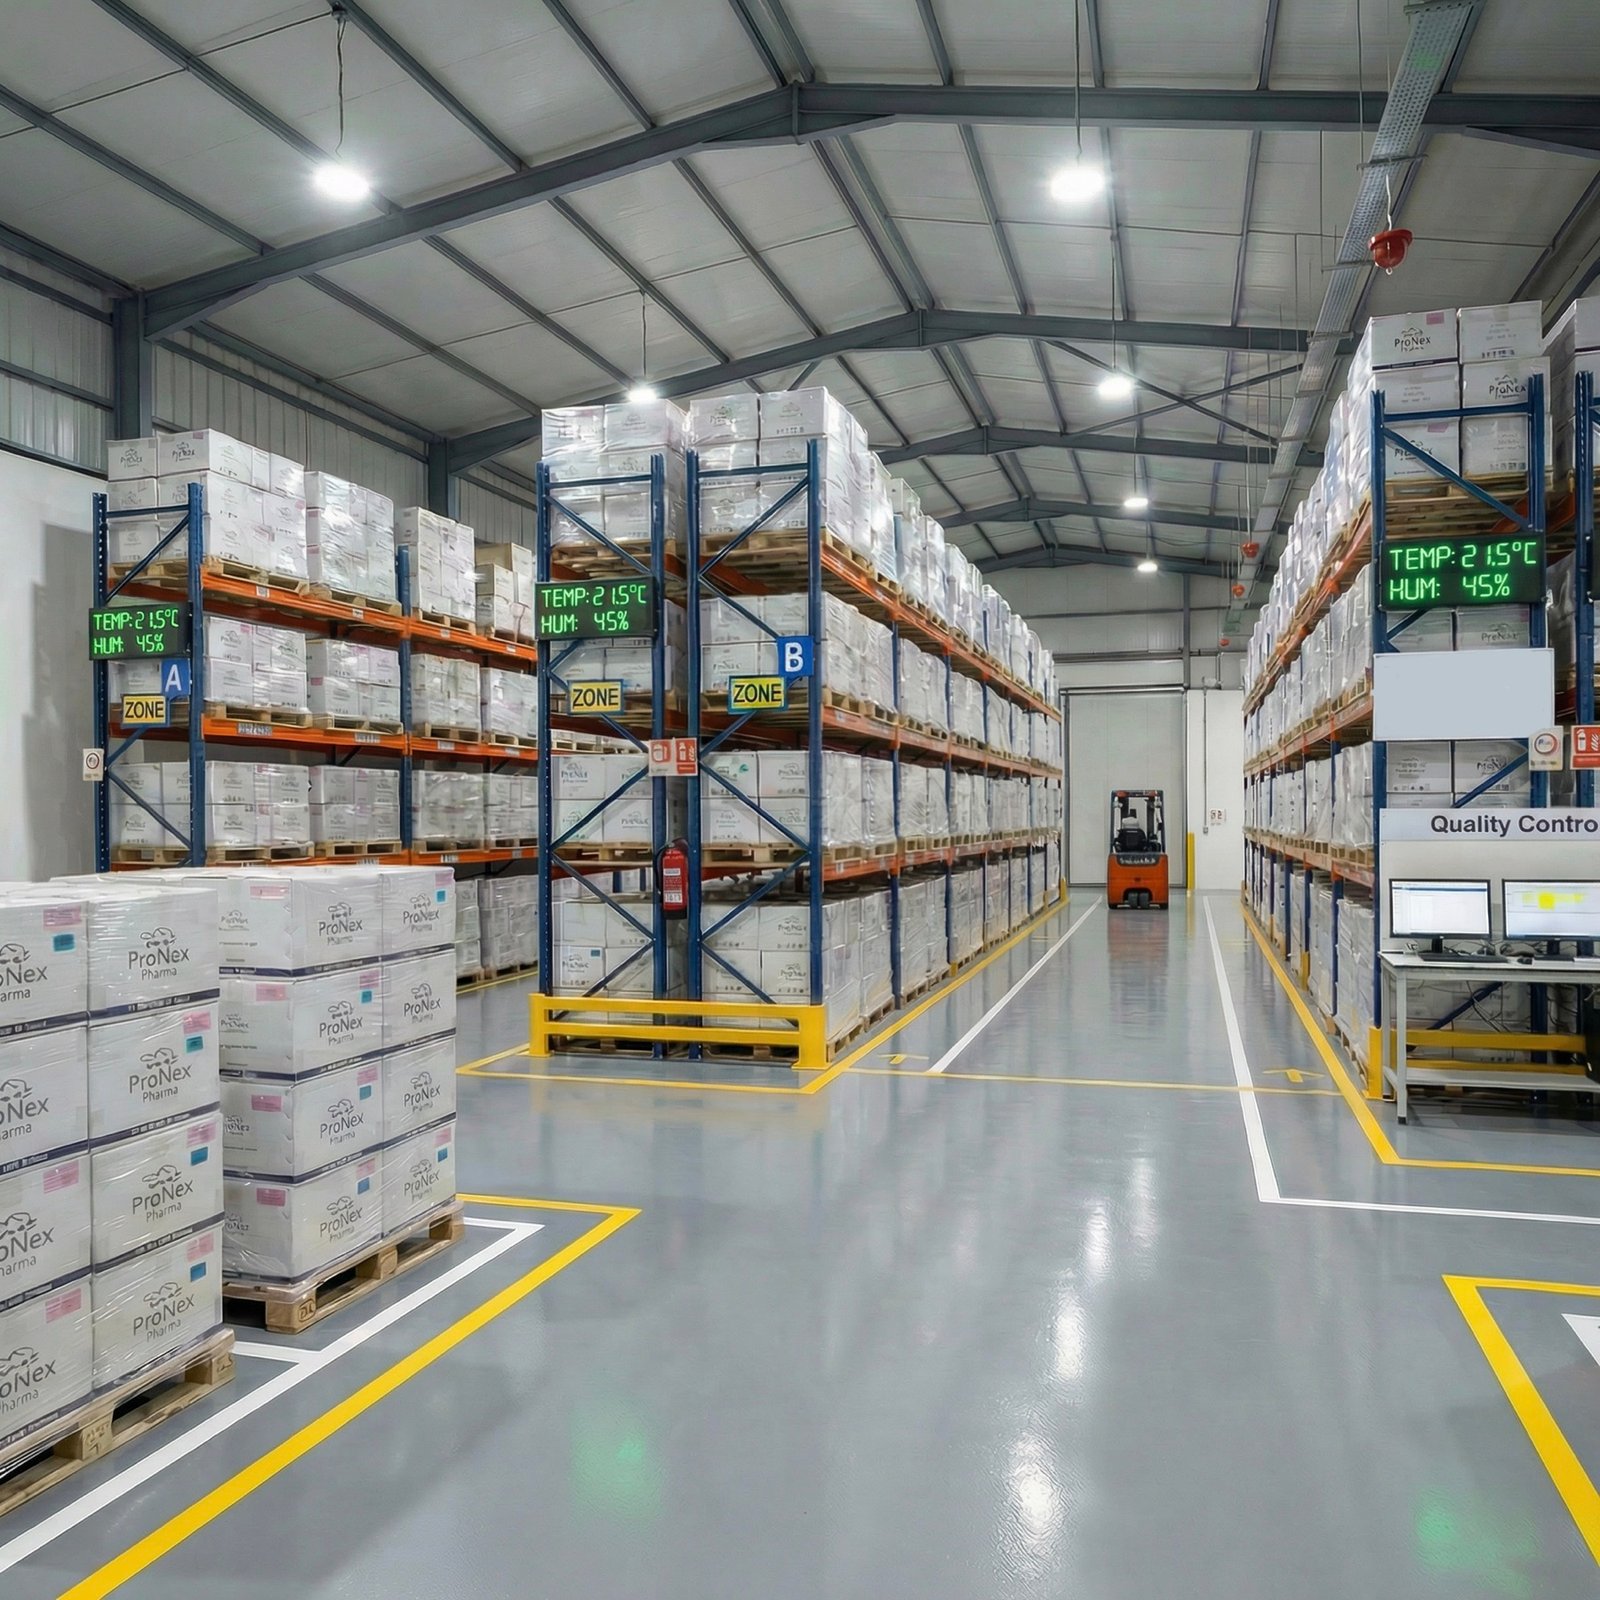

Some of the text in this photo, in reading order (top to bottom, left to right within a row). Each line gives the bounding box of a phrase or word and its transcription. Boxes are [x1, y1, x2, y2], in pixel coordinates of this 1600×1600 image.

[1390, 546, 1456, 570] TEMP:
[541, 587, 590, 608] TEMP:
[1390, 573, 1510, 600] HUM: 45%
[93, 612, 133, 631] TEMP:
[541, 610, 629, 634] HUM: 45%
[93, 636, 124, 655] HUM:
[784, 642, 804, 673] B
[164, 664, 182, 692] A
[572, 688, 619, 710] ZONE
[733, 683, 782, 703] ZONE
[124, 700, 165, 719] ZONE
[1430, 814, 1599, 838] Quality Contro
[319, 918, 362, 936] ProNex
[128, 947, 190, 970] ProNex
[141, 967, 178, 981] Pharma
[404, 998, 441, 1018] ProNex
[319, 1016, 363, 1038] ProNex
[129, 1064, 192, 1094] ProNex
[142, 1086, 178, 1103] Pharma
[404, 1085, 441, 1108] ProNex
[320, 1112, 364, 1138] ProNex
[404, 1171, 440, 1198] ProNex
[132, 1179, 194, 1215] ProNex
[146, 1202, 182, 1223] Pharma
[320, 1206, 363, 1238] ProNex
[133, 1294, 196, 1336] ProNex
[146, 1319, 182, 1344] Pharma
[0, 1359, 57, 1399] oNex
